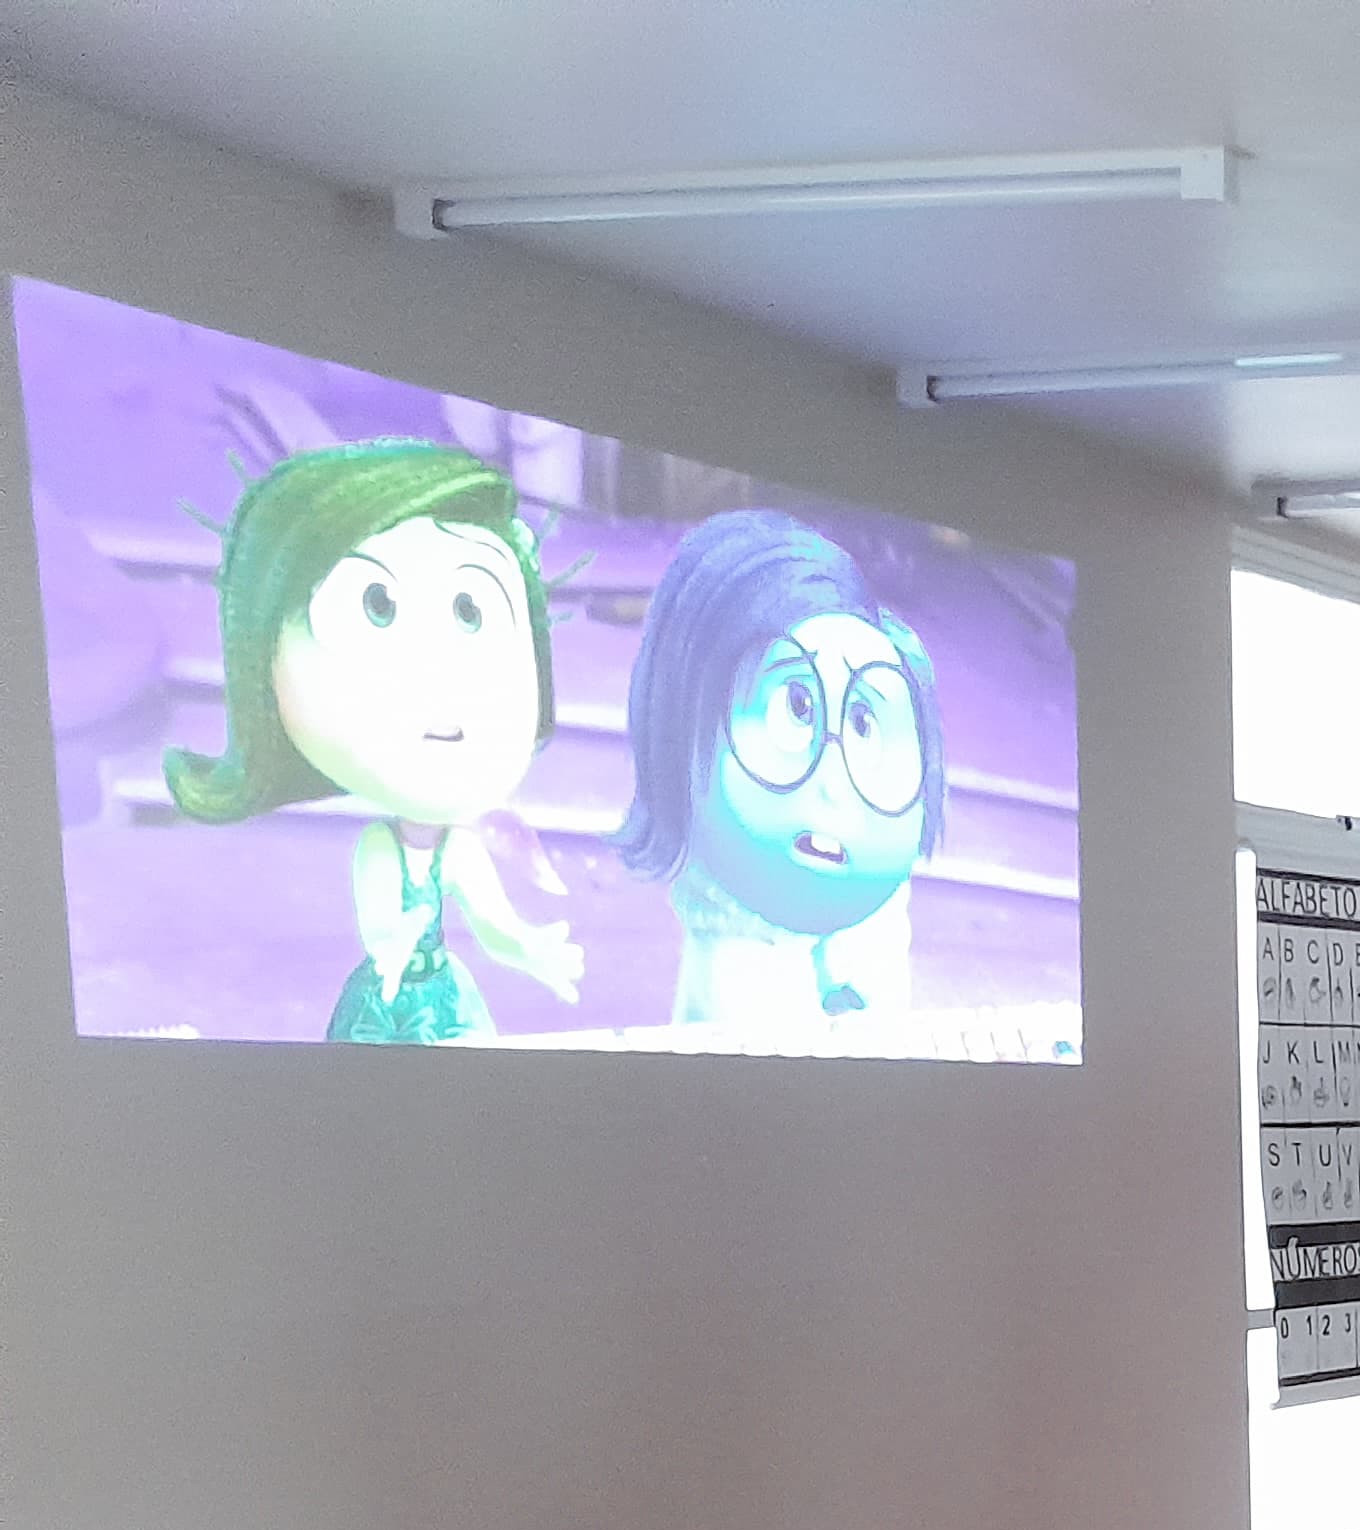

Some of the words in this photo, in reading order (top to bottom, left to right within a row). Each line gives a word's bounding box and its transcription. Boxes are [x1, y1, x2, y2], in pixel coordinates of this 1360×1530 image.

[1256, 878, 1357, 918] ALFABETO
[1262, 937, 1275, 961] A
[1283, 938, 1295, 963] B
[1307, 940, 1320, 964] C
[1333, 943, 1344, 966] D
[1262, 1041, 1271, 1064] J
[1286, 1041, 1300, 1064] K
[1313, 1040, 1324, 1064] L
[1337, 1041, 1351, 1064] M
[1268, 1143, 1281, 1167] S
[1291, 1142, 1302, 1166] T
[1319, 1144, 1331, 1167] U
[1342, 1144, 1352, 1166] V
[1280, 1317, 1289, 1338] 0
[1305, 1315, 1313, 1336] 1
[1322, 1314, 1331, 1336] 2
